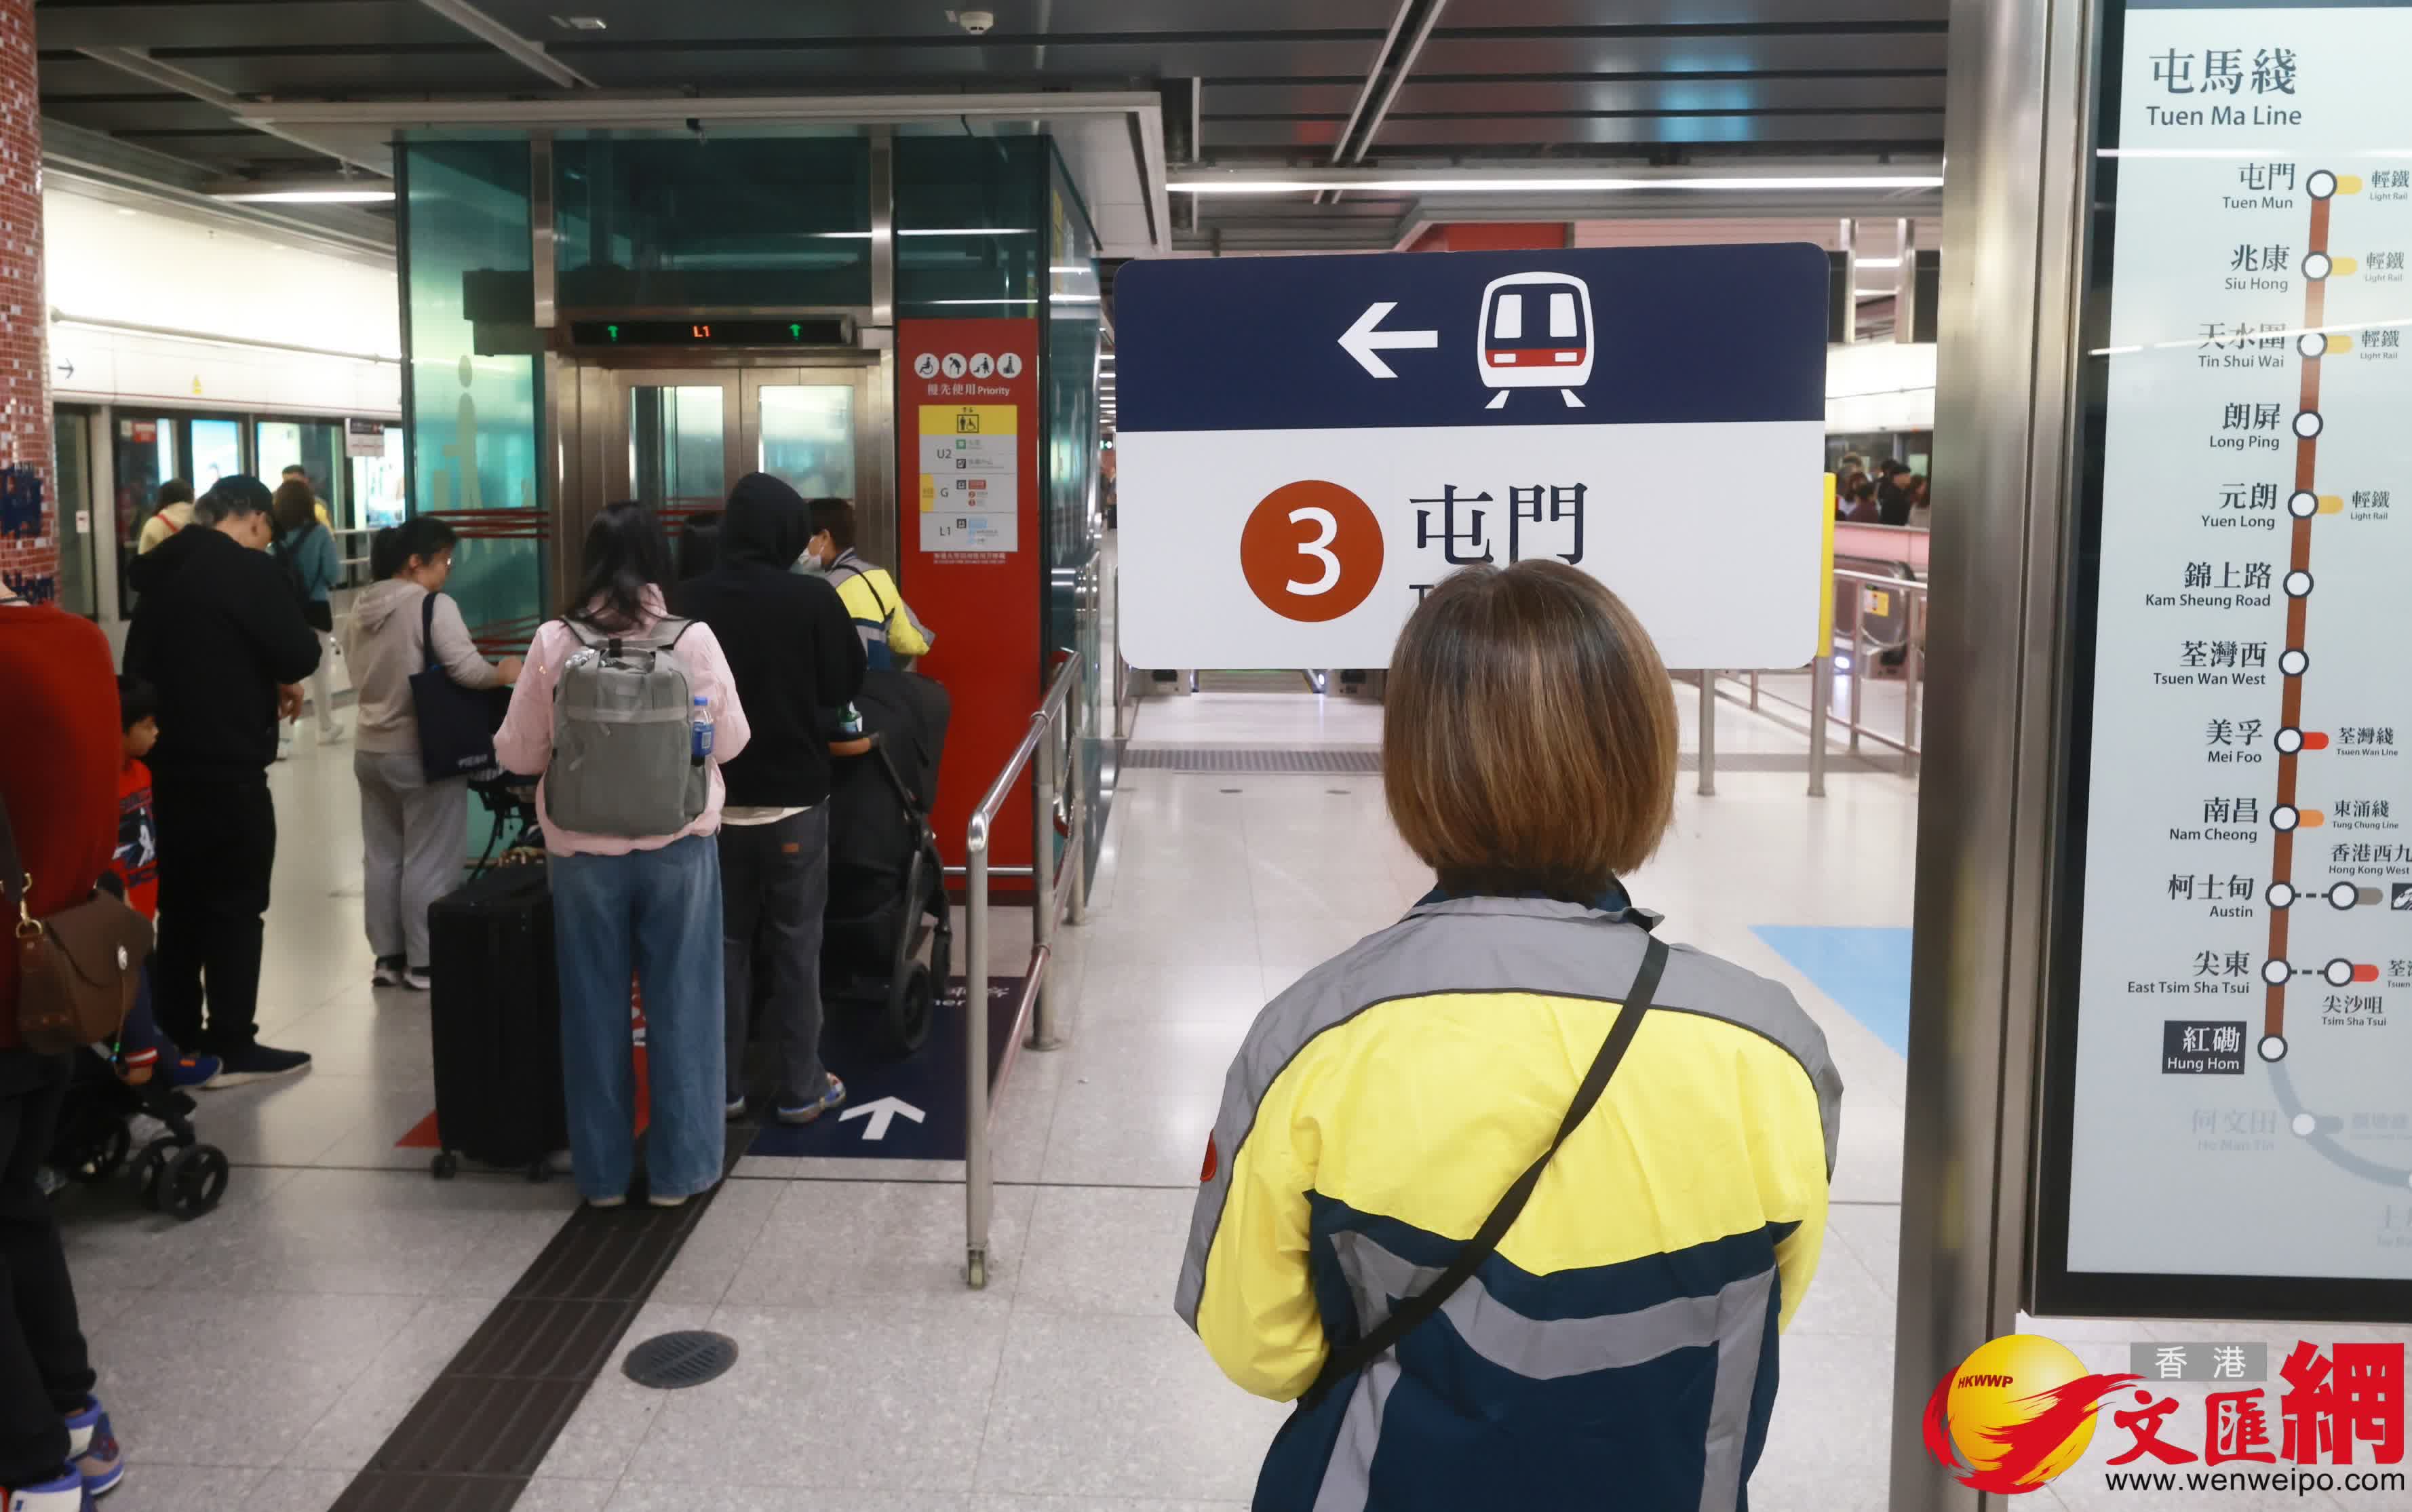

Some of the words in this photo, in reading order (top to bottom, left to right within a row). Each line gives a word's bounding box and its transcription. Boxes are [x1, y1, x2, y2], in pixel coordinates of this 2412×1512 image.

[2149, 48, 2297, 94] 屯馬綫
[2147, 106, 2204, 125] Tuen
[2211, 106, 2246, 125] Ma
[2253, 106, 2302, 125] Line
[2238, 163, 2295, 191] 屯門
[2371, 170, 2409, 188] 輕鐵
[2222, 197, 2257, 209] Tuen
[2261, 197, 2293, 209] Mun
[2369, 191, 2390, 201] Light
[2393, 192, 2408, 200] Rail
[2230, 244, 2290, 272] 兆康
[2366, 251, 2404, 270] 輕鐵
[2225, 277, 2246, 290] Siu
[2251, 277, 2289, 293] Hong
[693, 325, 712, 338] L1
[2198, 322, 2286, 350] 天水圍
[2361, 330, 2399, 348] 輕鐵
[2198, 355, 2219, 368] Tin
[2223, 355, 2254, 368] Shui
[2258, 355, 2284, 368] Wai
[2360, 352, 2380, 360] Light
[977, 386, 1010, 396] Priority
[2222, 402, 2280, 430] 朗屏
[2210, 435, 2244, 450] Long
[2249, 435, 2280, 450] Ping
[937, 448, 952, 459] U2
[939, 487, 949, 498] G
[2219, 482, 2278, 510] 元朗
[2352, 490, 2390, 509] 輕鐵
[1409, 482, 1588, 565] 屯門
[2202, 516, 2236, 528] Yuen
[2240, 515, 2275, 530] Long
[2350, 511, 2371, 521] Light
[2373, 512, 2388, 520] Rail
[939, 526, 951, 537] L1
[1286, 507, 1341, 596] 3
[2184, 562, 2272, 589] 錦上路
[2145, 594, 2176, 606] Kam
[2179, 594, 2232, 609] Sheung
[2236, 594, 2271, 606] Road
[2180, 640, 2268, 668] 荃灣西
[2154, 673, 2194, 685] Tsuen
[2198, 673, 2228, 684] Wan
[2232, 673, 2265, 684] West
[2206, 718, 2263, 746] 美孚
[2338, 726, 2394, 745] 荃灣綫
[2208, 750, 2233, 762] Mei
[2236, 751, 2262, 763] Foo
[2337, 748, 2360, 756] Tsuen
[2203, 796, 2258, 824] 南昌
[2333, 800, 2390, 818] 東涌綫
[2333, 821, 2352, 830] Tung
[2354, 821, 2381, 830] Chung
[2169, 828, 2200, 840] Nam
[2204, 828, 2257, 843] Cheong
[2329, 865, 2355, 876] Hong
[2357, 865, 2384, 876] Kong
[2386, 865, 2410, 875] West
[2168, 874, 2255, 901] 柯士甸
[2209, 906, 2254, 918] Austin
[2192, 950, 2251, 977] 尖東
[2128, 982, 2155, 993] East
[2158, 982, 2191, 994] Tsim
[2194, 982, 2218, 994] Sha
[2222, 982, 2250, 994] Tsui
[2322, 995, 2384, 1015] 尖沙咀
[2321, 1017, 2345, 1026] Tsim
[2347, 1017, 2365, 1026] Sha
[2367, 1017, 2387, 1026] Tsui
[2182, 1026, 2241, 1054] 紅磡
[2168, 1058, 2204, 1072] Hung
[2207, 1058, 2240, 1070] Hom
